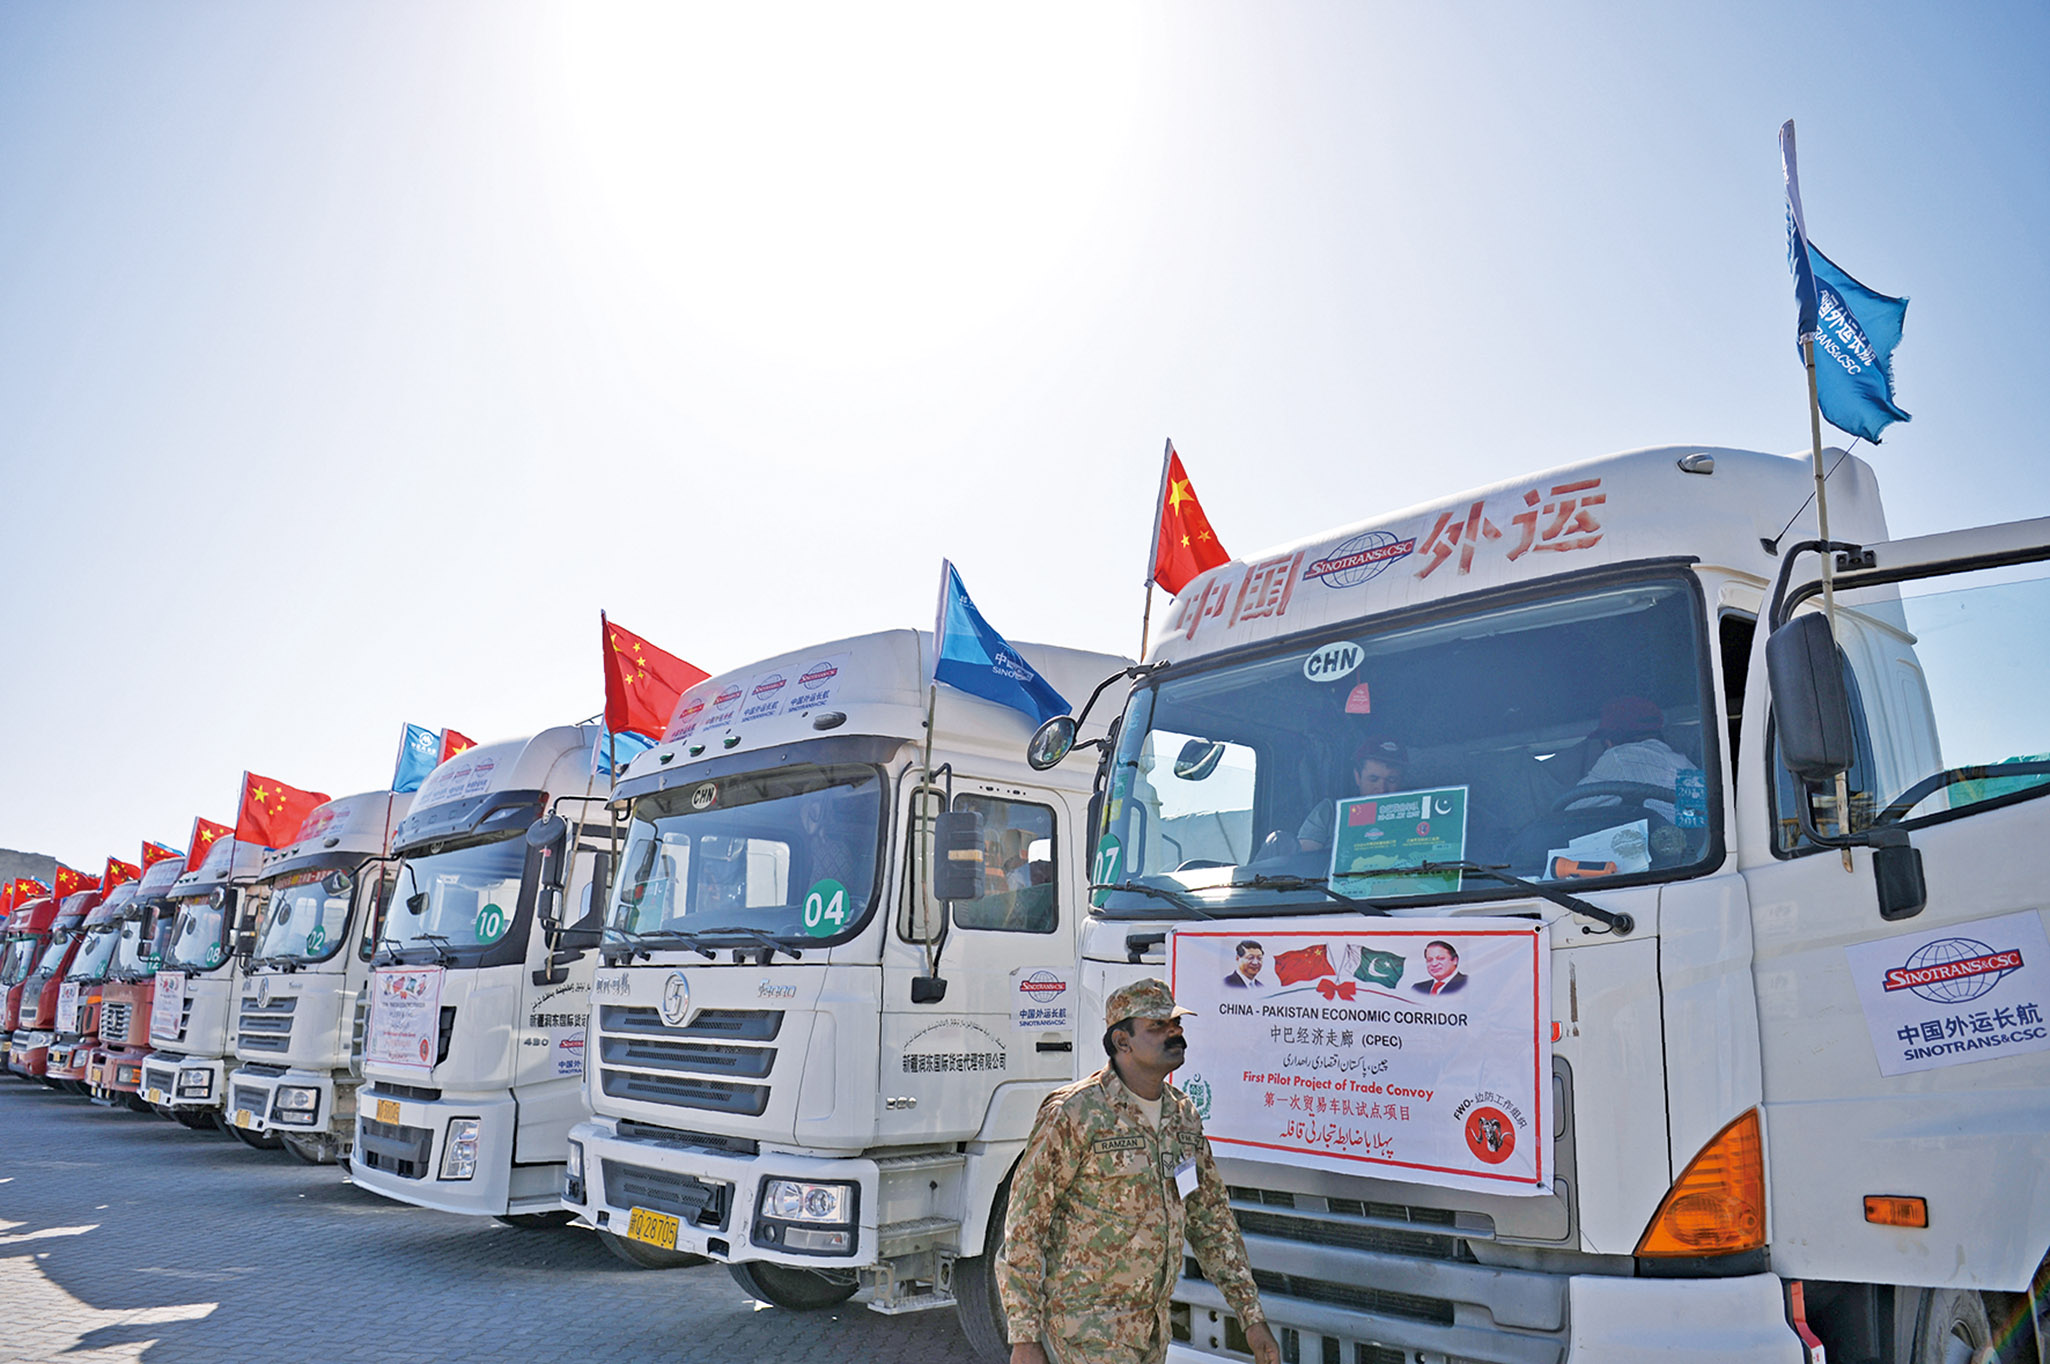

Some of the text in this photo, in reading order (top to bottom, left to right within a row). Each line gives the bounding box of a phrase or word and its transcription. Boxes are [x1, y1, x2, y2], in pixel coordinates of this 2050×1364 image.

[1175, 479, 1606, 640] 中国 外运
[1304, 541, 1413, 578] SINOTRANS&CSC
[1308, 647, 1358, 676] CHN
[694, 787, 715, 804] CHN
[804, 890, 845, 928] 04
[480, 912, 500, 937] 10
[206, 946, 220, 963] 08
[1887, 952, 2020, 990] SINOTRANS&CSC
[1019, 1008, 1067, 1019] 中国外运长航
[1219, 1003, 1253, 1016] CHINA
[1262, 1005, 1319, 1019] PAKISTAN
[1322, 1008, 1391, 1023] ECONOMIC
[1394, 1011, 1468, 1026] CORRIDOR
[1897, 1002, 2043, 1046] 中国外运长航
[1270, 1025, 1403, 1049] 中巴经济走廊 (CPEC)
[1903, 1027, 2048, 1061] SINOTRANS&CSC
[1243, 1071, 1434, 1102] First Pilot Project of Trade Convoy
[1264, 1091, 1410, 1121] 第一次贸易车队试点项目
[1101, 1142, 1138, 1150] RAMZAN
